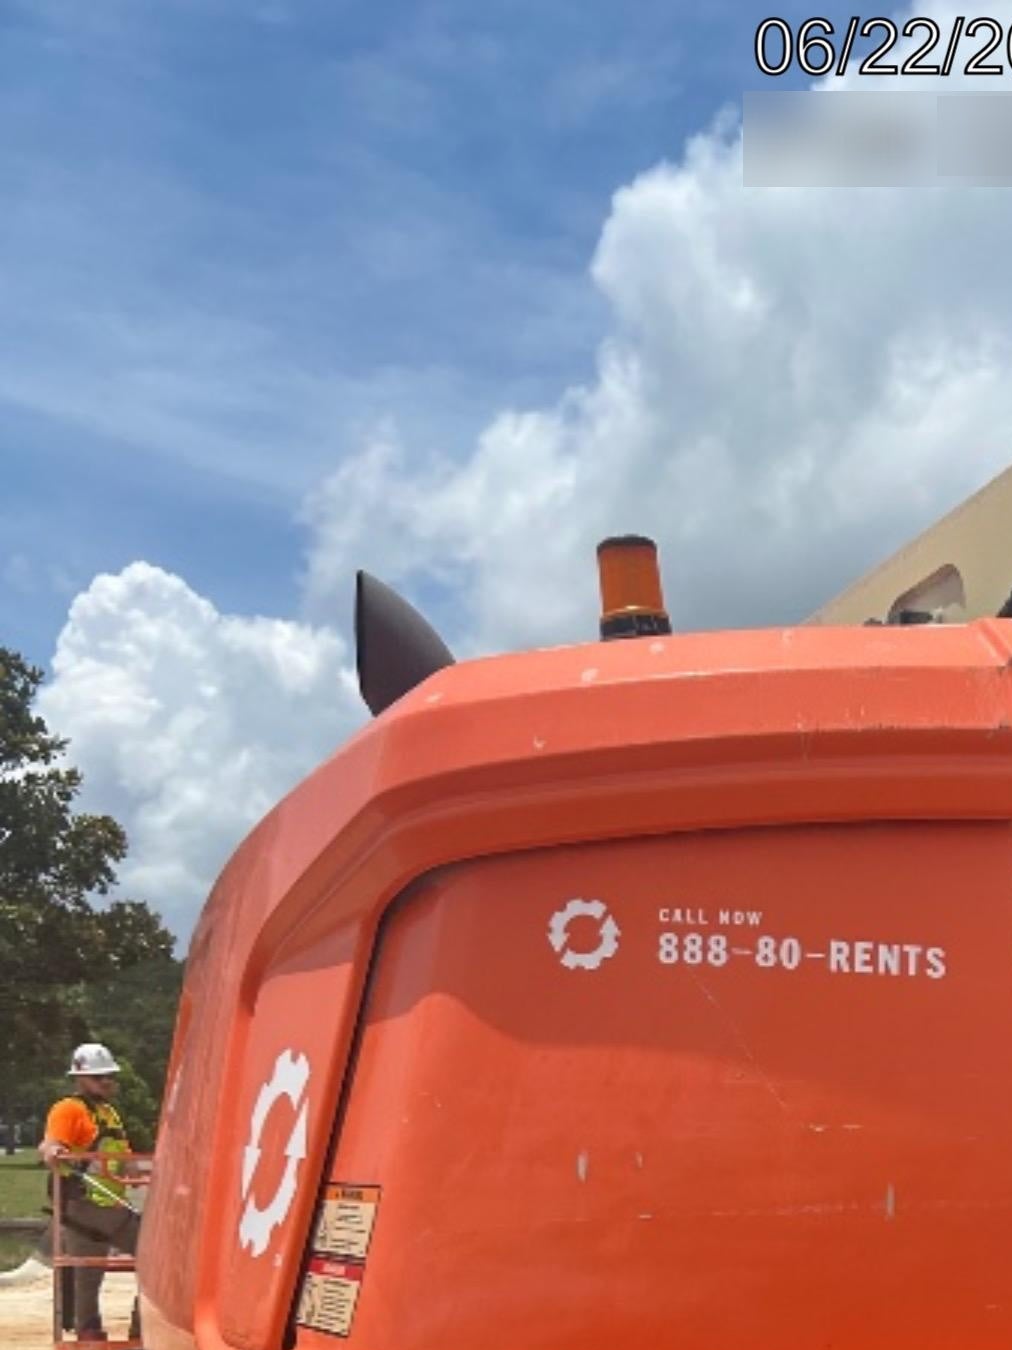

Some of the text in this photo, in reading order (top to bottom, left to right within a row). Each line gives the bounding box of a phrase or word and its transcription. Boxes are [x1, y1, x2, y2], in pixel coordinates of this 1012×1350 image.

[658, 908, 763, 926] CALL NOW
[658, 932, 947, 979] 888-80-RENTS
